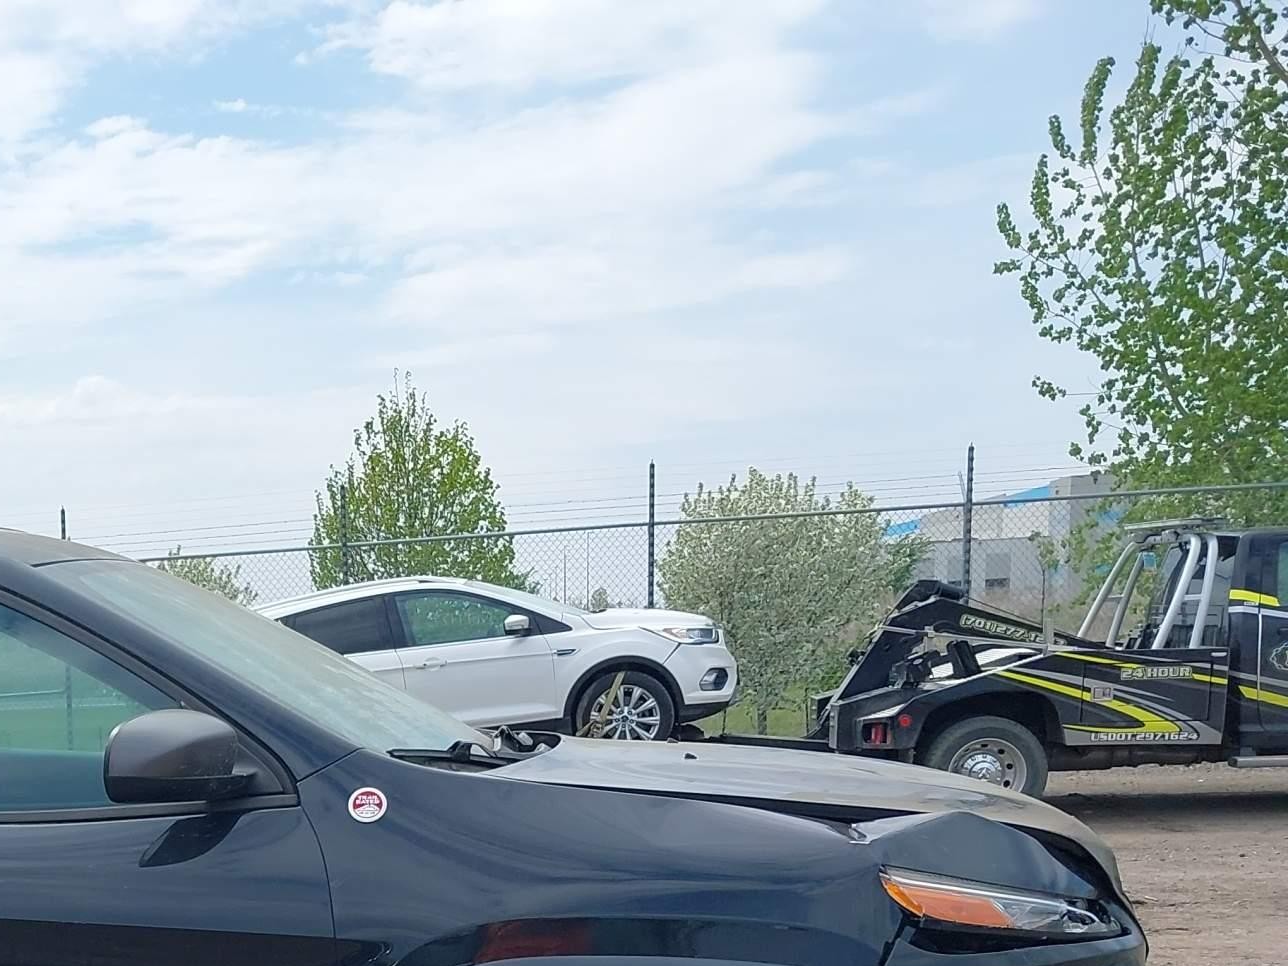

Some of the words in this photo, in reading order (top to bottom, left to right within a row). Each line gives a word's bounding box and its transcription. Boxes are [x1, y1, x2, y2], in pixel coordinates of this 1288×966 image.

[960, 614, 1067, 646] (701)277-12
[1121, 667, 1144, 680] 24
[1145, 666, 1192, 680] HOUR
[1091, 733, 1132, 742] USDOT
[1135, 731, 1199, 742] 2971624
